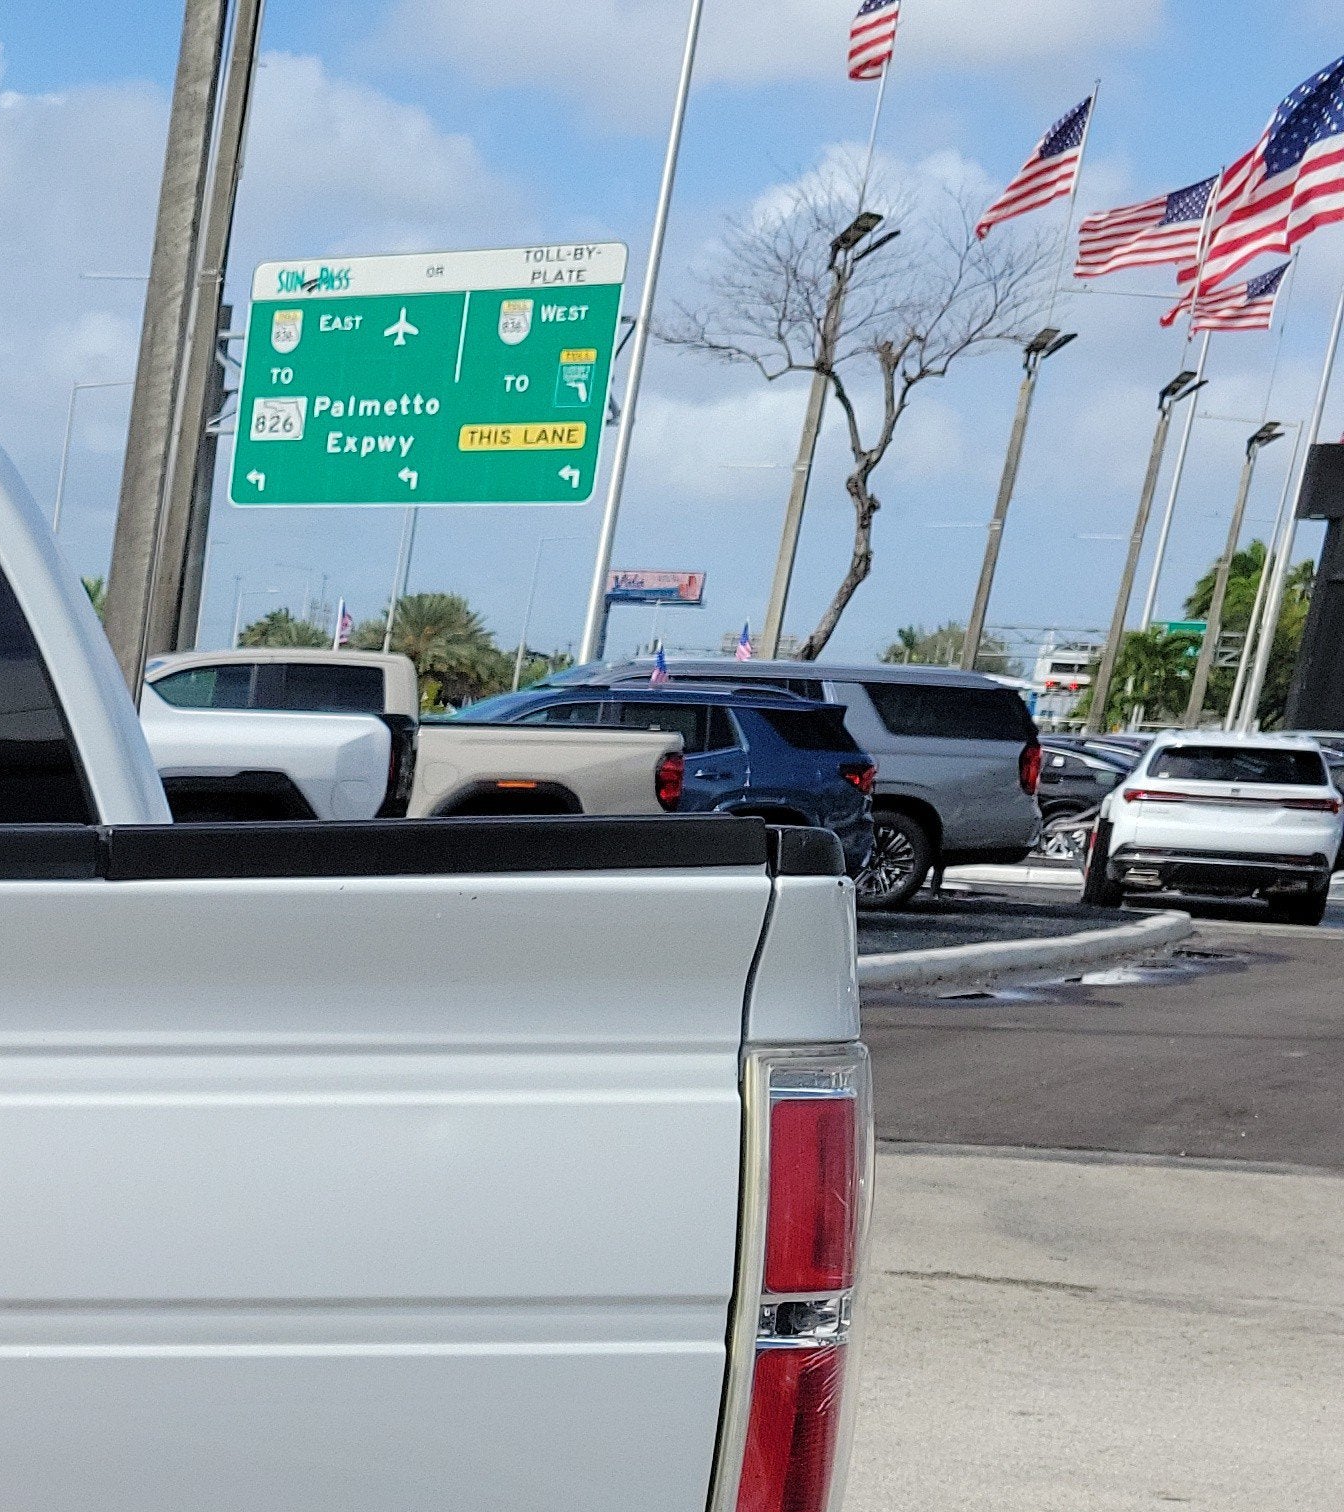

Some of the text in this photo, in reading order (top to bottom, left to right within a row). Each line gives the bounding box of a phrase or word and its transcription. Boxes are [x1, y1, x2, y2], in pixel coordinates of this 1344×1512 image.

[524, 246, 602, 264] TOLL-BY-
[426, 265, 445, 278] OR
[530, 269, 587, 285] PLATE
[319, 314, 363, 331] EAST
[540, 304, 589, 323] WEST
[270, 367, 294, 385] TO
[503, 374, 530, 393] TO
[314, 393, 440, 418] Palmetto
[254, 415, 294, 434] 826
[326, 431, 415, 458] Expwy
[467, 427, 579, 446] THIS LANE
